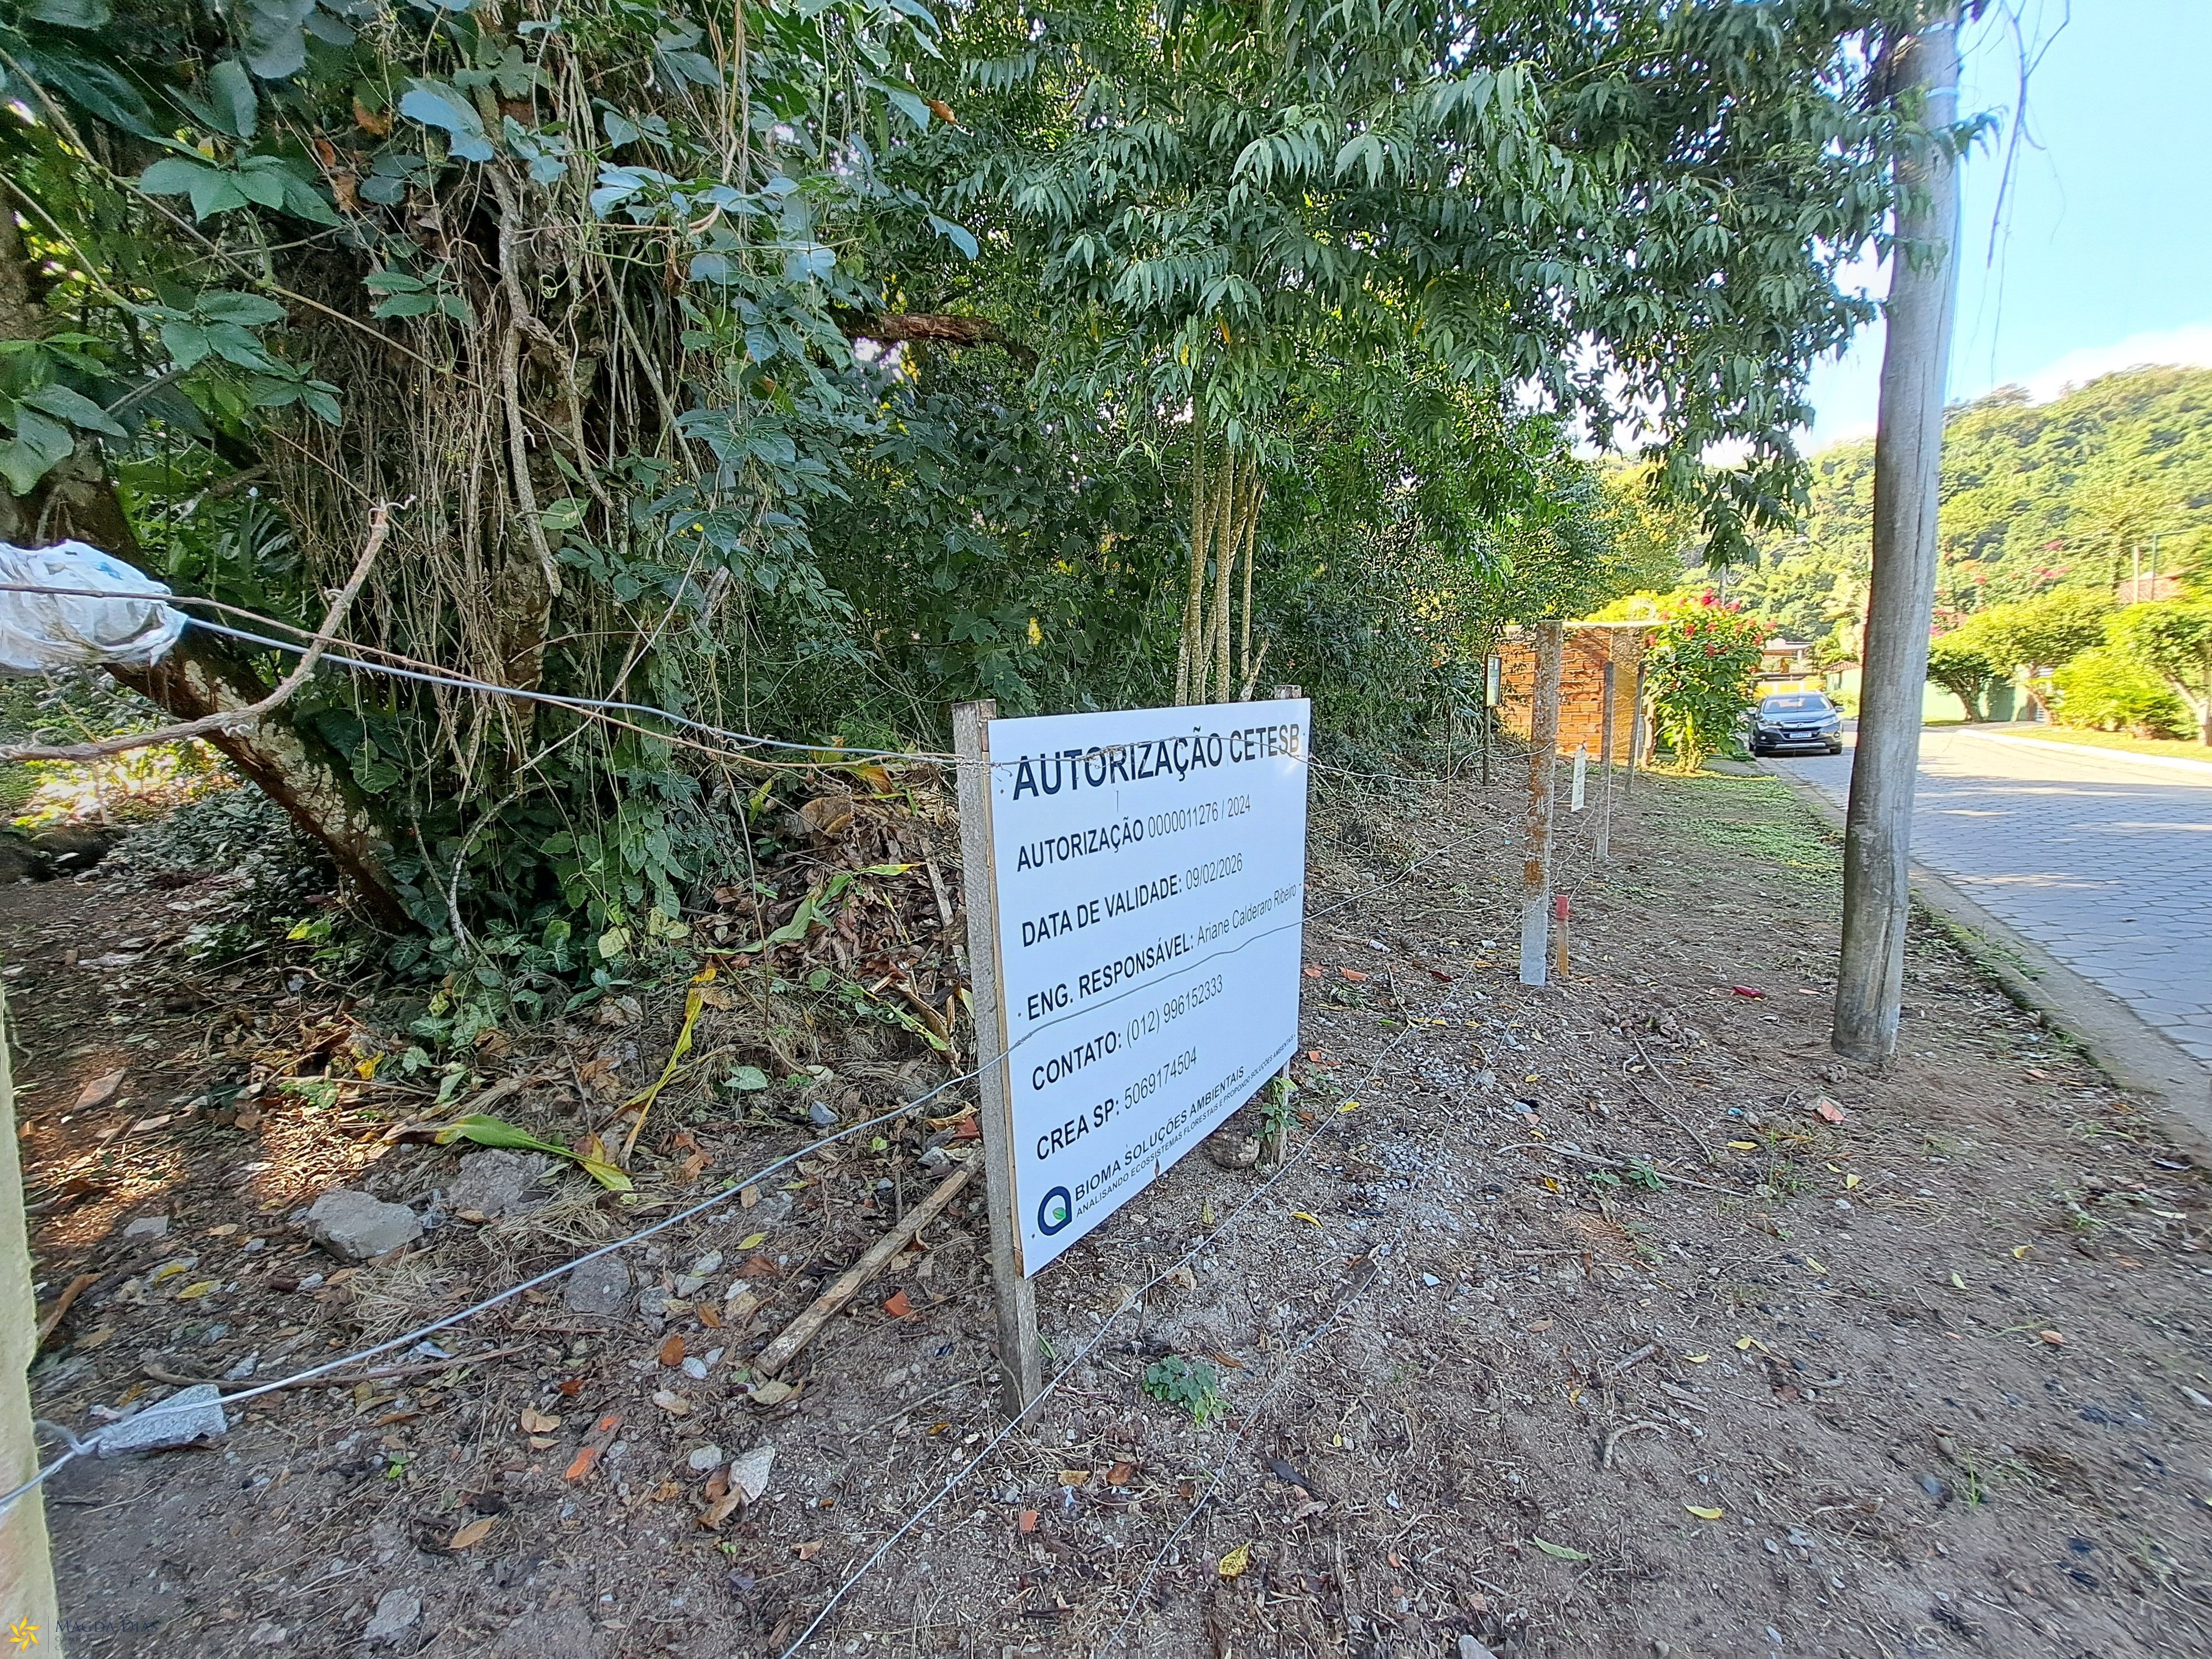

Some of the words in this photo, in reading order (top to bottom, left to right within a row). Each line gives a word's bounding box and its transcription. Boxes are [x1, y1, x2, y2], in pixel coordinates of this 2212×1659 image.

[1013, 726, 1222, 801] AUTORIZAÇÃO
[1229, 723, 1300, 763] CETESB
[1016, 816, 1144, 873] AUTORIZAÇÃO
[1147, 801, 1218, 838] 0000011276
[1221, 799, 1224, 820] /
[1227, 794, 1251, 818] 2024
[1022, 909, 1073, 948] DATA
[1077, 899, 1100, 929] DE
[1104, 873, 1182, 918] VALIDADE:
[1186, 852, 1243, 890] 09/02/2026
[1027, 983, 1073, 1021] ENG.
[1079, 932, 1193, 999] RESPONSÁVEL:
[1197, 919, 1229, 947] Ariane
[1232, 898, 1272, 929] Calderaro
[1274, 883, 1296, 908] Ribeiro
[1032, 1031, 1121, 1091] CONTATO:
[1126, 1008, 1160, 1049] (012)
[1163, 974, 1223, 1024] 996152333
[1036, 1114, 1090, 1160] CREA
[1093, 1098, 1119, 1128] SP:
[1124, 1045, 1197, 1110] 5069174504
[1075, 1159, 1121, 1202] BIOMA
[1124, 1109, 1187, 1166] SOLUÇÕES
[1189, 1066, 1244, 1118] AMBIENTAIS
[1076, 1172, 1129, 1218] ANALISANDO
[1130, 1131, 1182, 1177] ECOSSISTEMAS
[1183, 1103, 1218, 1136] FLORESTAIS
[1219, 1098, 1223, 1107] E
[1223, 1075, 1250, 1103] PROPONDO
[1250, 1055, 1273, 1079] SOLUÇÕES
